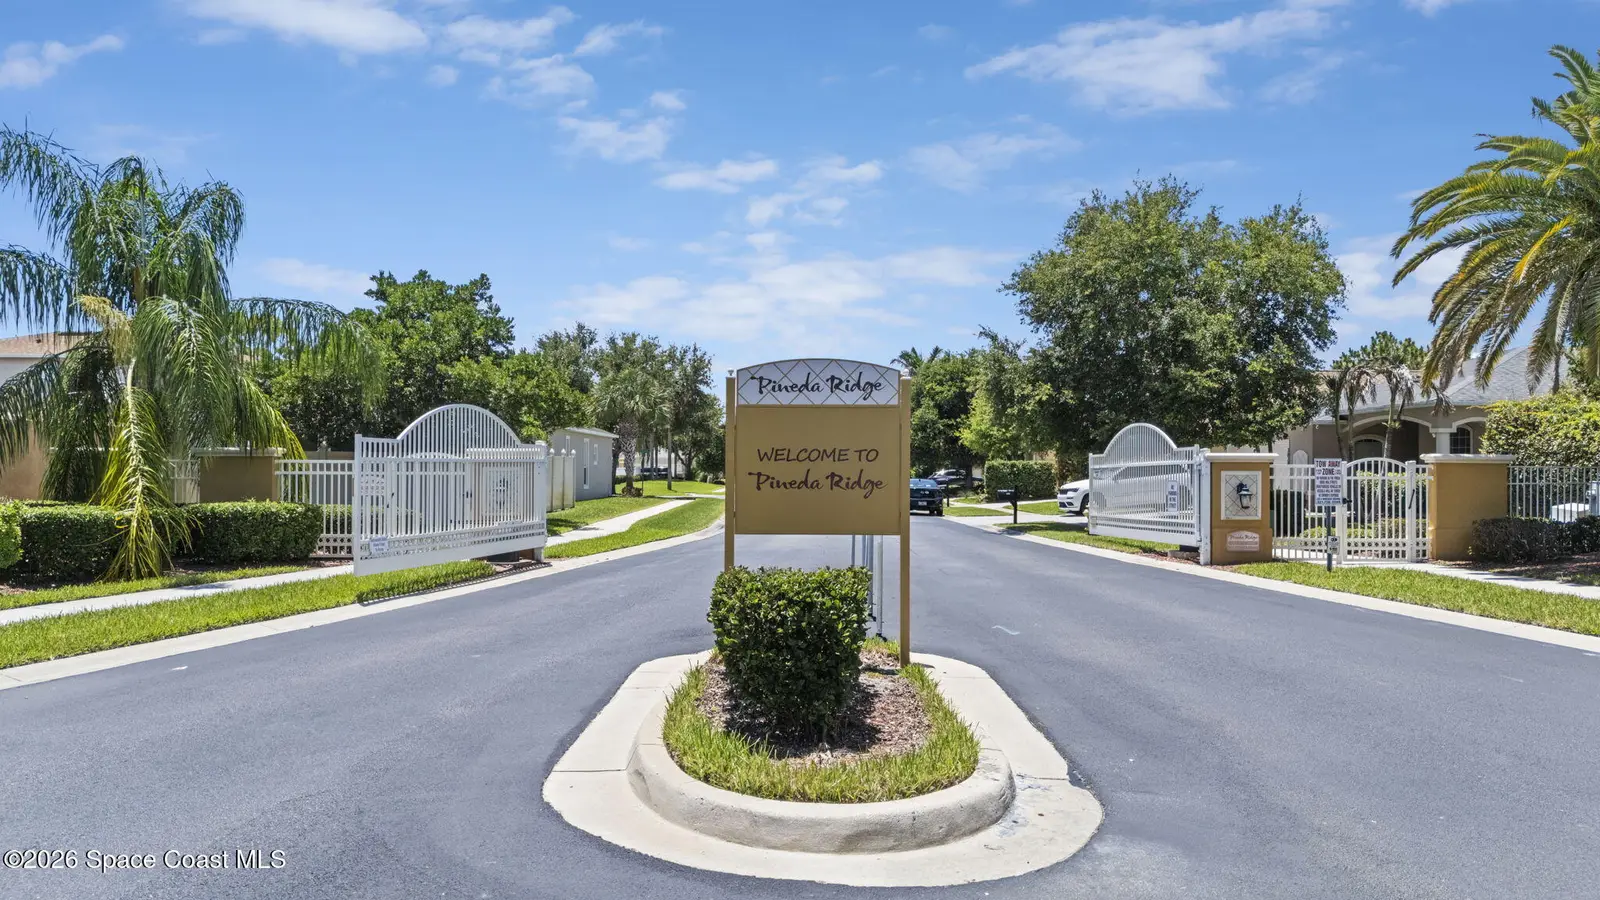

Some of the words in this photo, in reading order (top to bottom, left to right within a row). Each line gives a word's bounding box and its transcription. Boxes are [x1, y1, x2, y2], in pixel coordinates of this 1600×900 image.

[750, 372, 823, 395] Pineda
[826, 372, 884, 401] Ridge
[757, 447, 850, 463] WELCOME
[854, 448, 880, 463] TO
[748, 469, 823, 491] Pineda
[826, 469, 887, 499] Ridge
